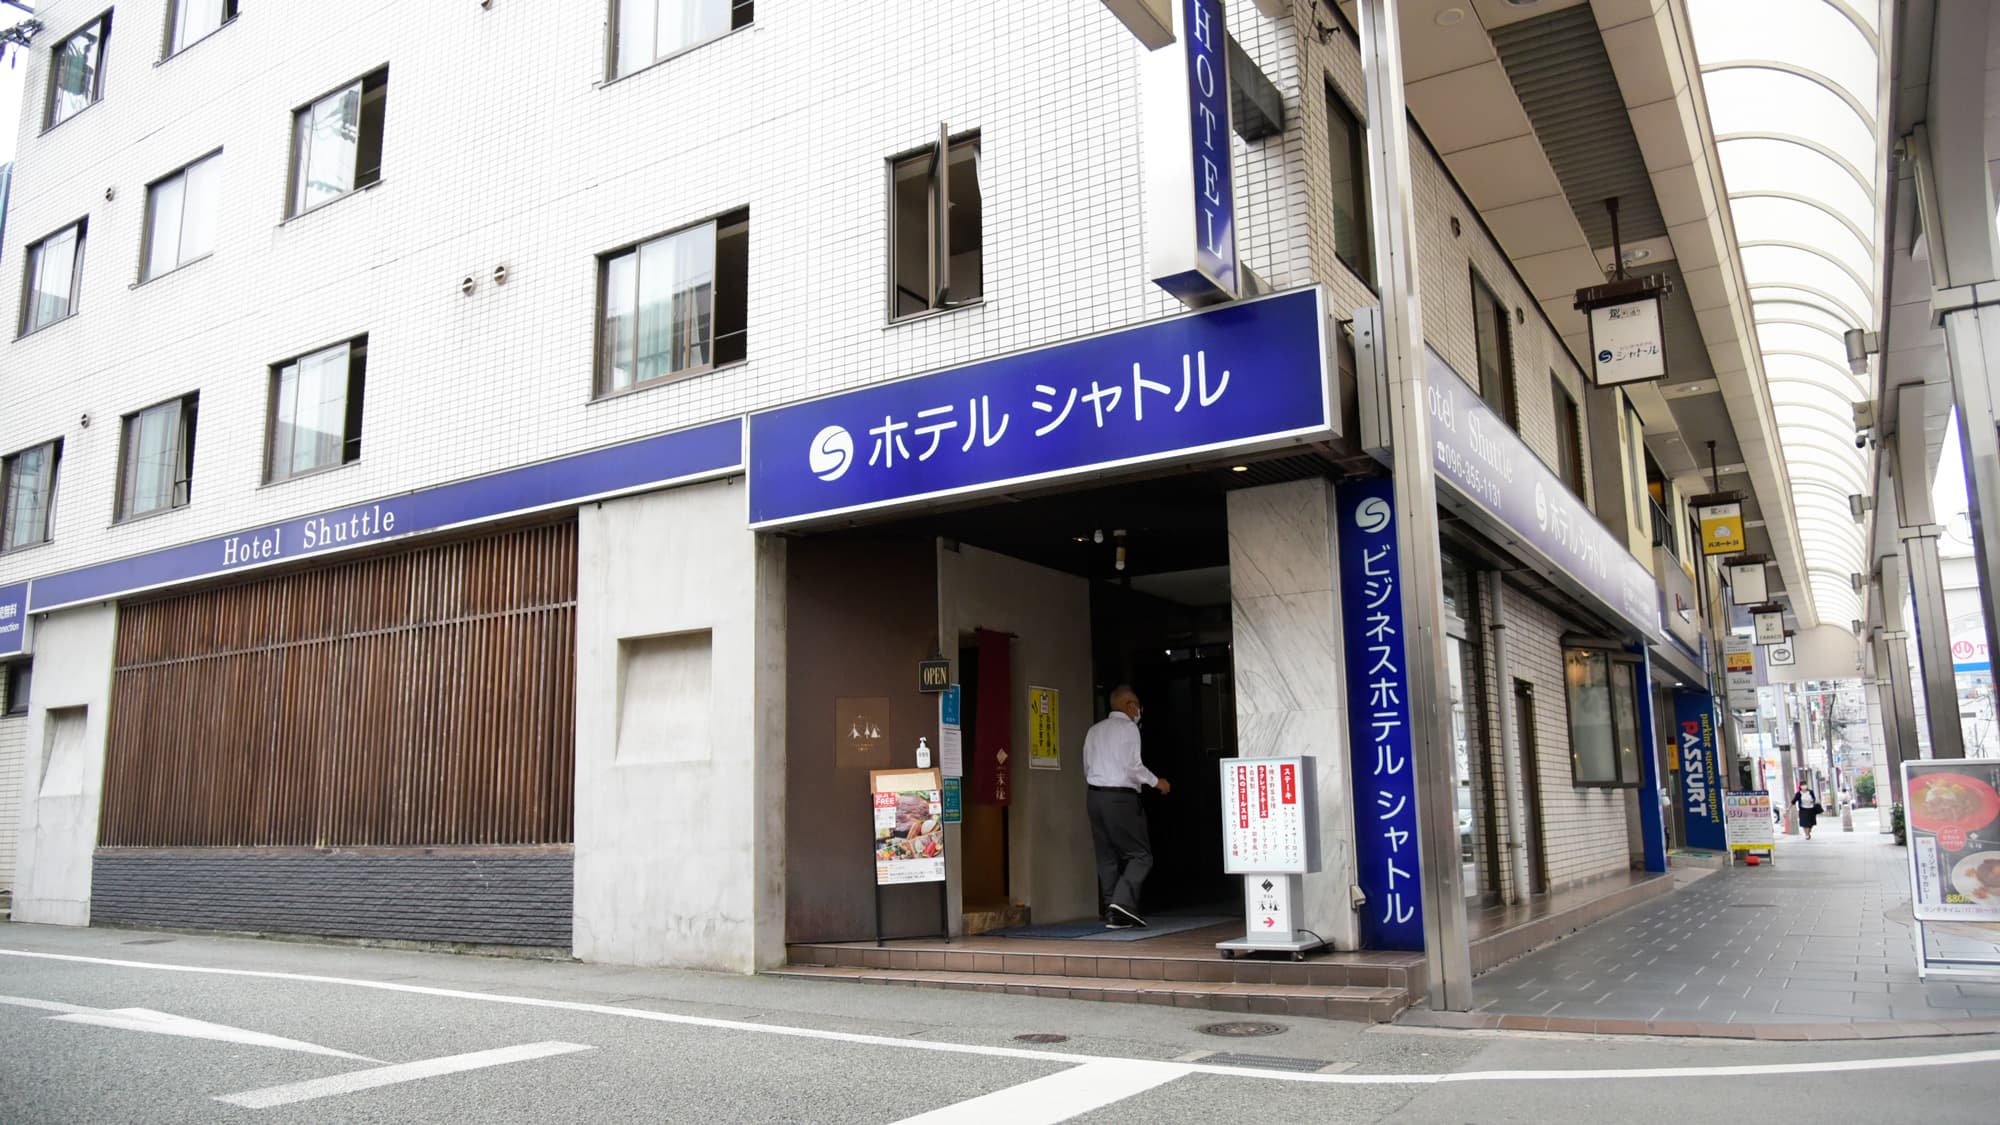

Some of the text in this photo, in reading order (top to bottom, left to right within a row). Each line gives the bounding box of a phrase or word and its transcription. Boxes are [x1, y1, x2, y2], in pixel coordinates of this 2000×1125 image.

[1193, 0, 1223, 259] HOTEL
[869, 352, 1230, 468] ホテル シャトル
[1428, 384, 1513, 483] otel Shuttle
[1445, 445, 1502, 509] 096-355-1131
[223, 505, 395, 565] Hotel Shuttle
[0, 622, 19, 633] nnection
[923, 667, 947, 685] OPEN
[1363, 545, 1415, 925] ビジネスホテル シャトル
[1681, 721, 1708, 816] PASSURT
[1700, 713, 1720, 823] parking success support
[875, 797, 896, 806] FREE
[1283, 767, 1293, 800] ステーキ
